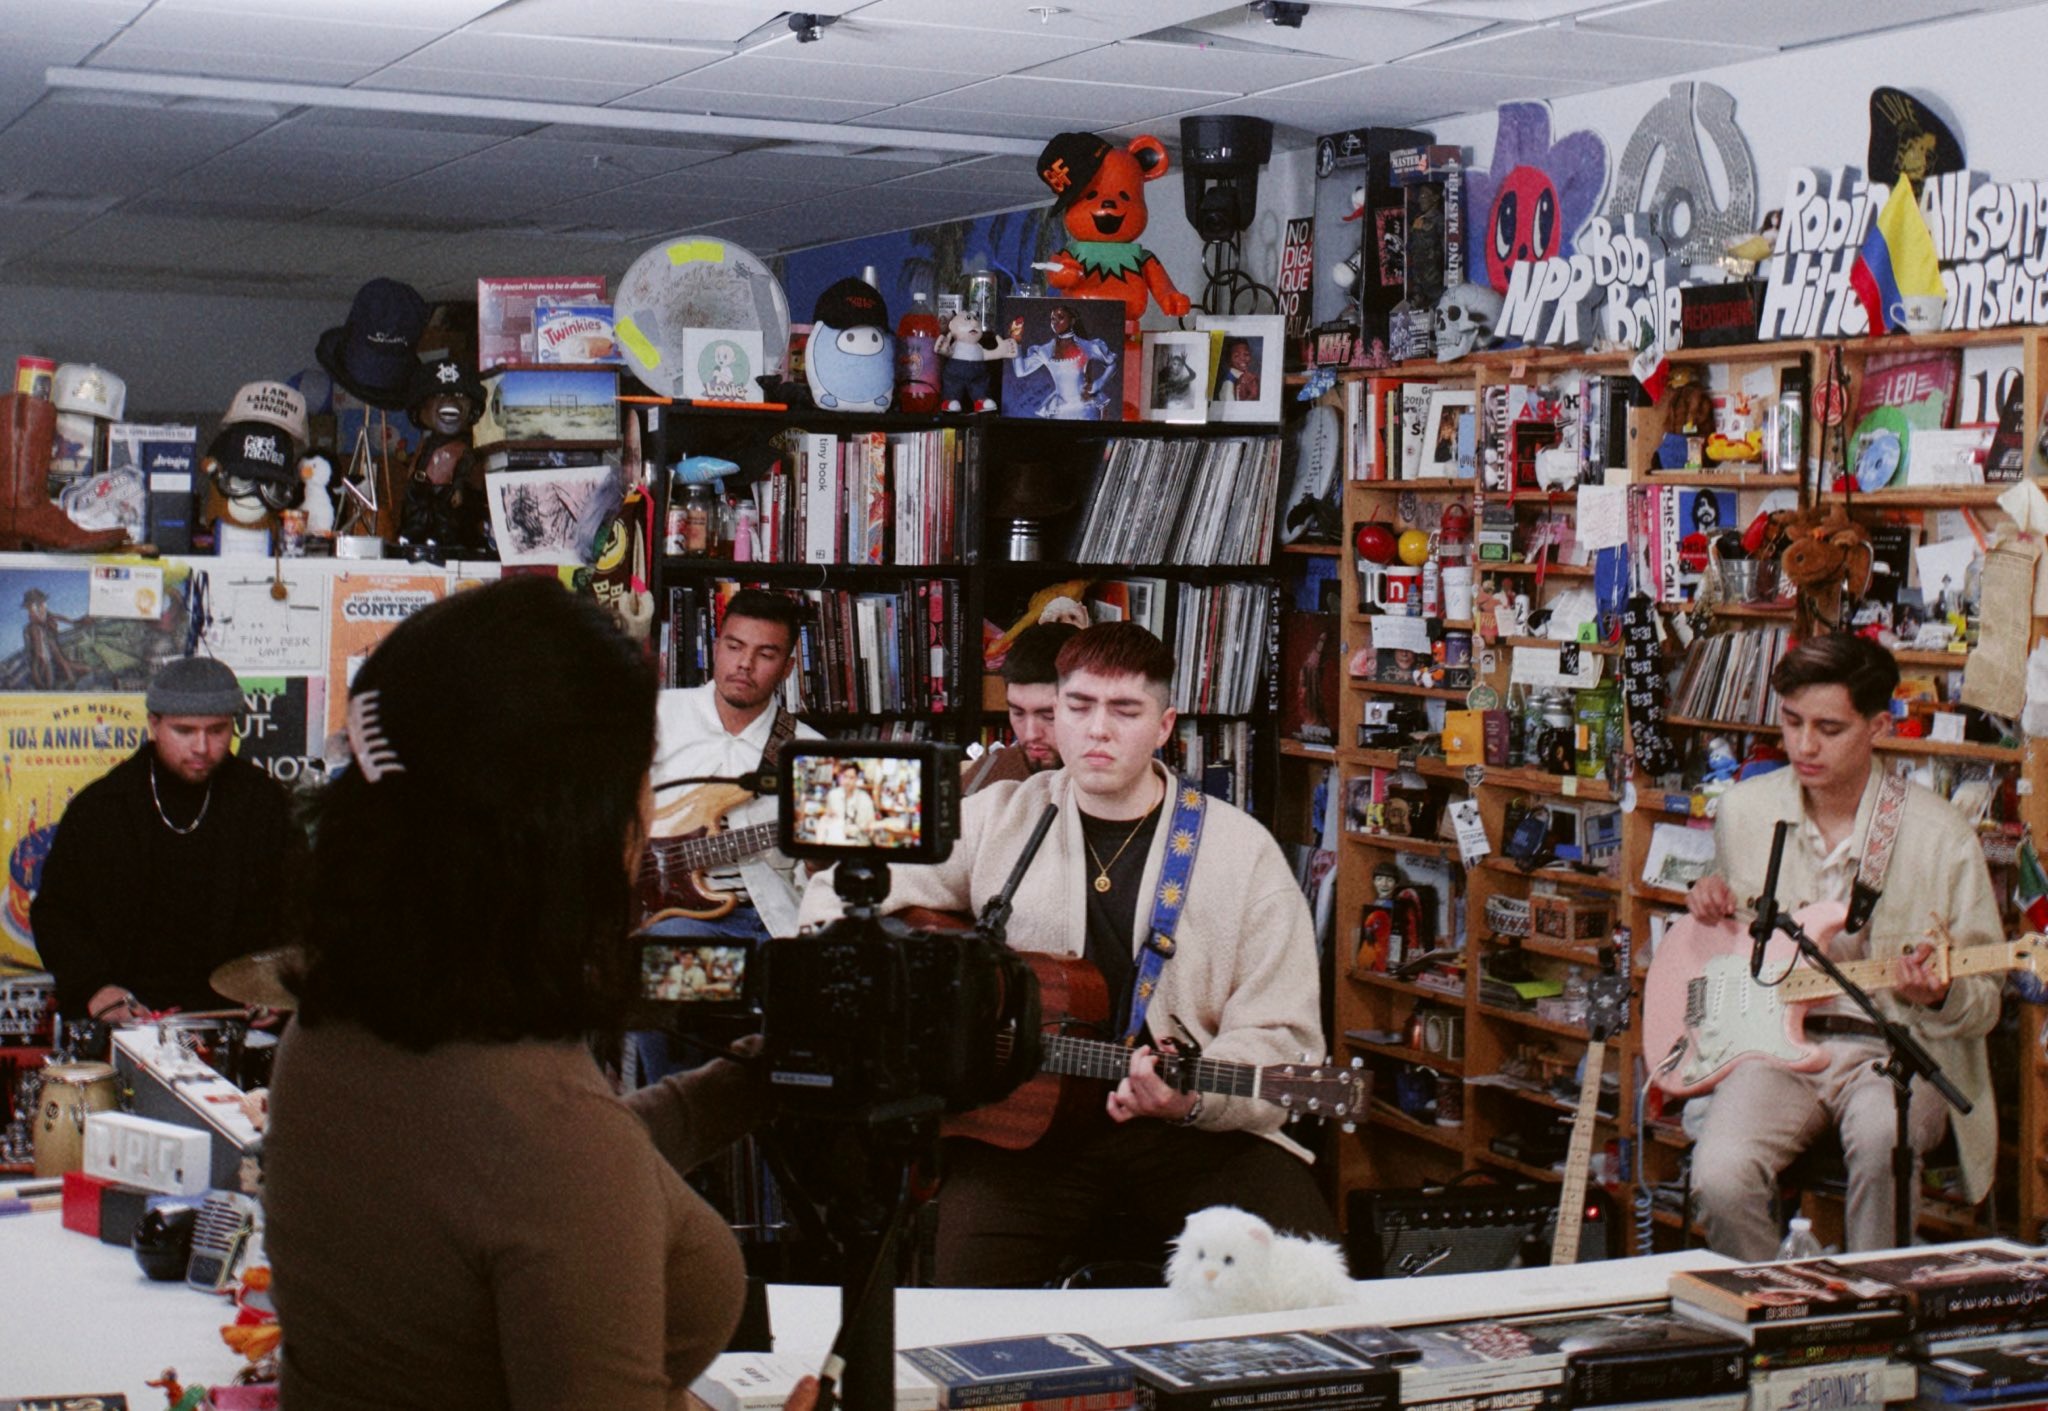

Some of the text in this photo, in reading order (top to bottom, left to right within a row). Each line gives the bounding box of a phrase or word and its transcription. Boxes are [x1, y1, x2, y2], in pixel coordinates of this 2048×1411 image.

[1448, 172, 1459, 234] MASTER
[1774, 166, 1891, 254] Robin
[1287, 222, 1309, 246] NO
[1592, 213, 1650, 287] Bob
[502, 282, 528, 291] doesn't
[529, 282, 545, 291] have
[546, 282, 554, 290] to
[555, 282, 563, 290] be
[1281, 268, 1310, 293] QUE
[1758, 247, 1869, 339] Hilto
[1279, 293, 1299, 316] NO
[1494, 254, 1594, 345] NPR
[1607, 257, 1684, 352] Boile
[543, 319, 602, 346] Twinkies
[1317, 332, 1352, 364] KISS
[247, 395, 298, 414] LAKSHMI
[268, 387, 289, 399] AM
[1404, 396, 1424, 406] 20th
[253, 403, 289, 418] SINGH
[1519, 400, 1563, 421] ASK
[818, 438, 829, 492] tiny book
[1664, 486, 1675, 527] THIS
[1664, 564, 1675, 598] CALL
[346, 602, 423, 616] CONTES
[88, 703, 132, 720] MUSIC
